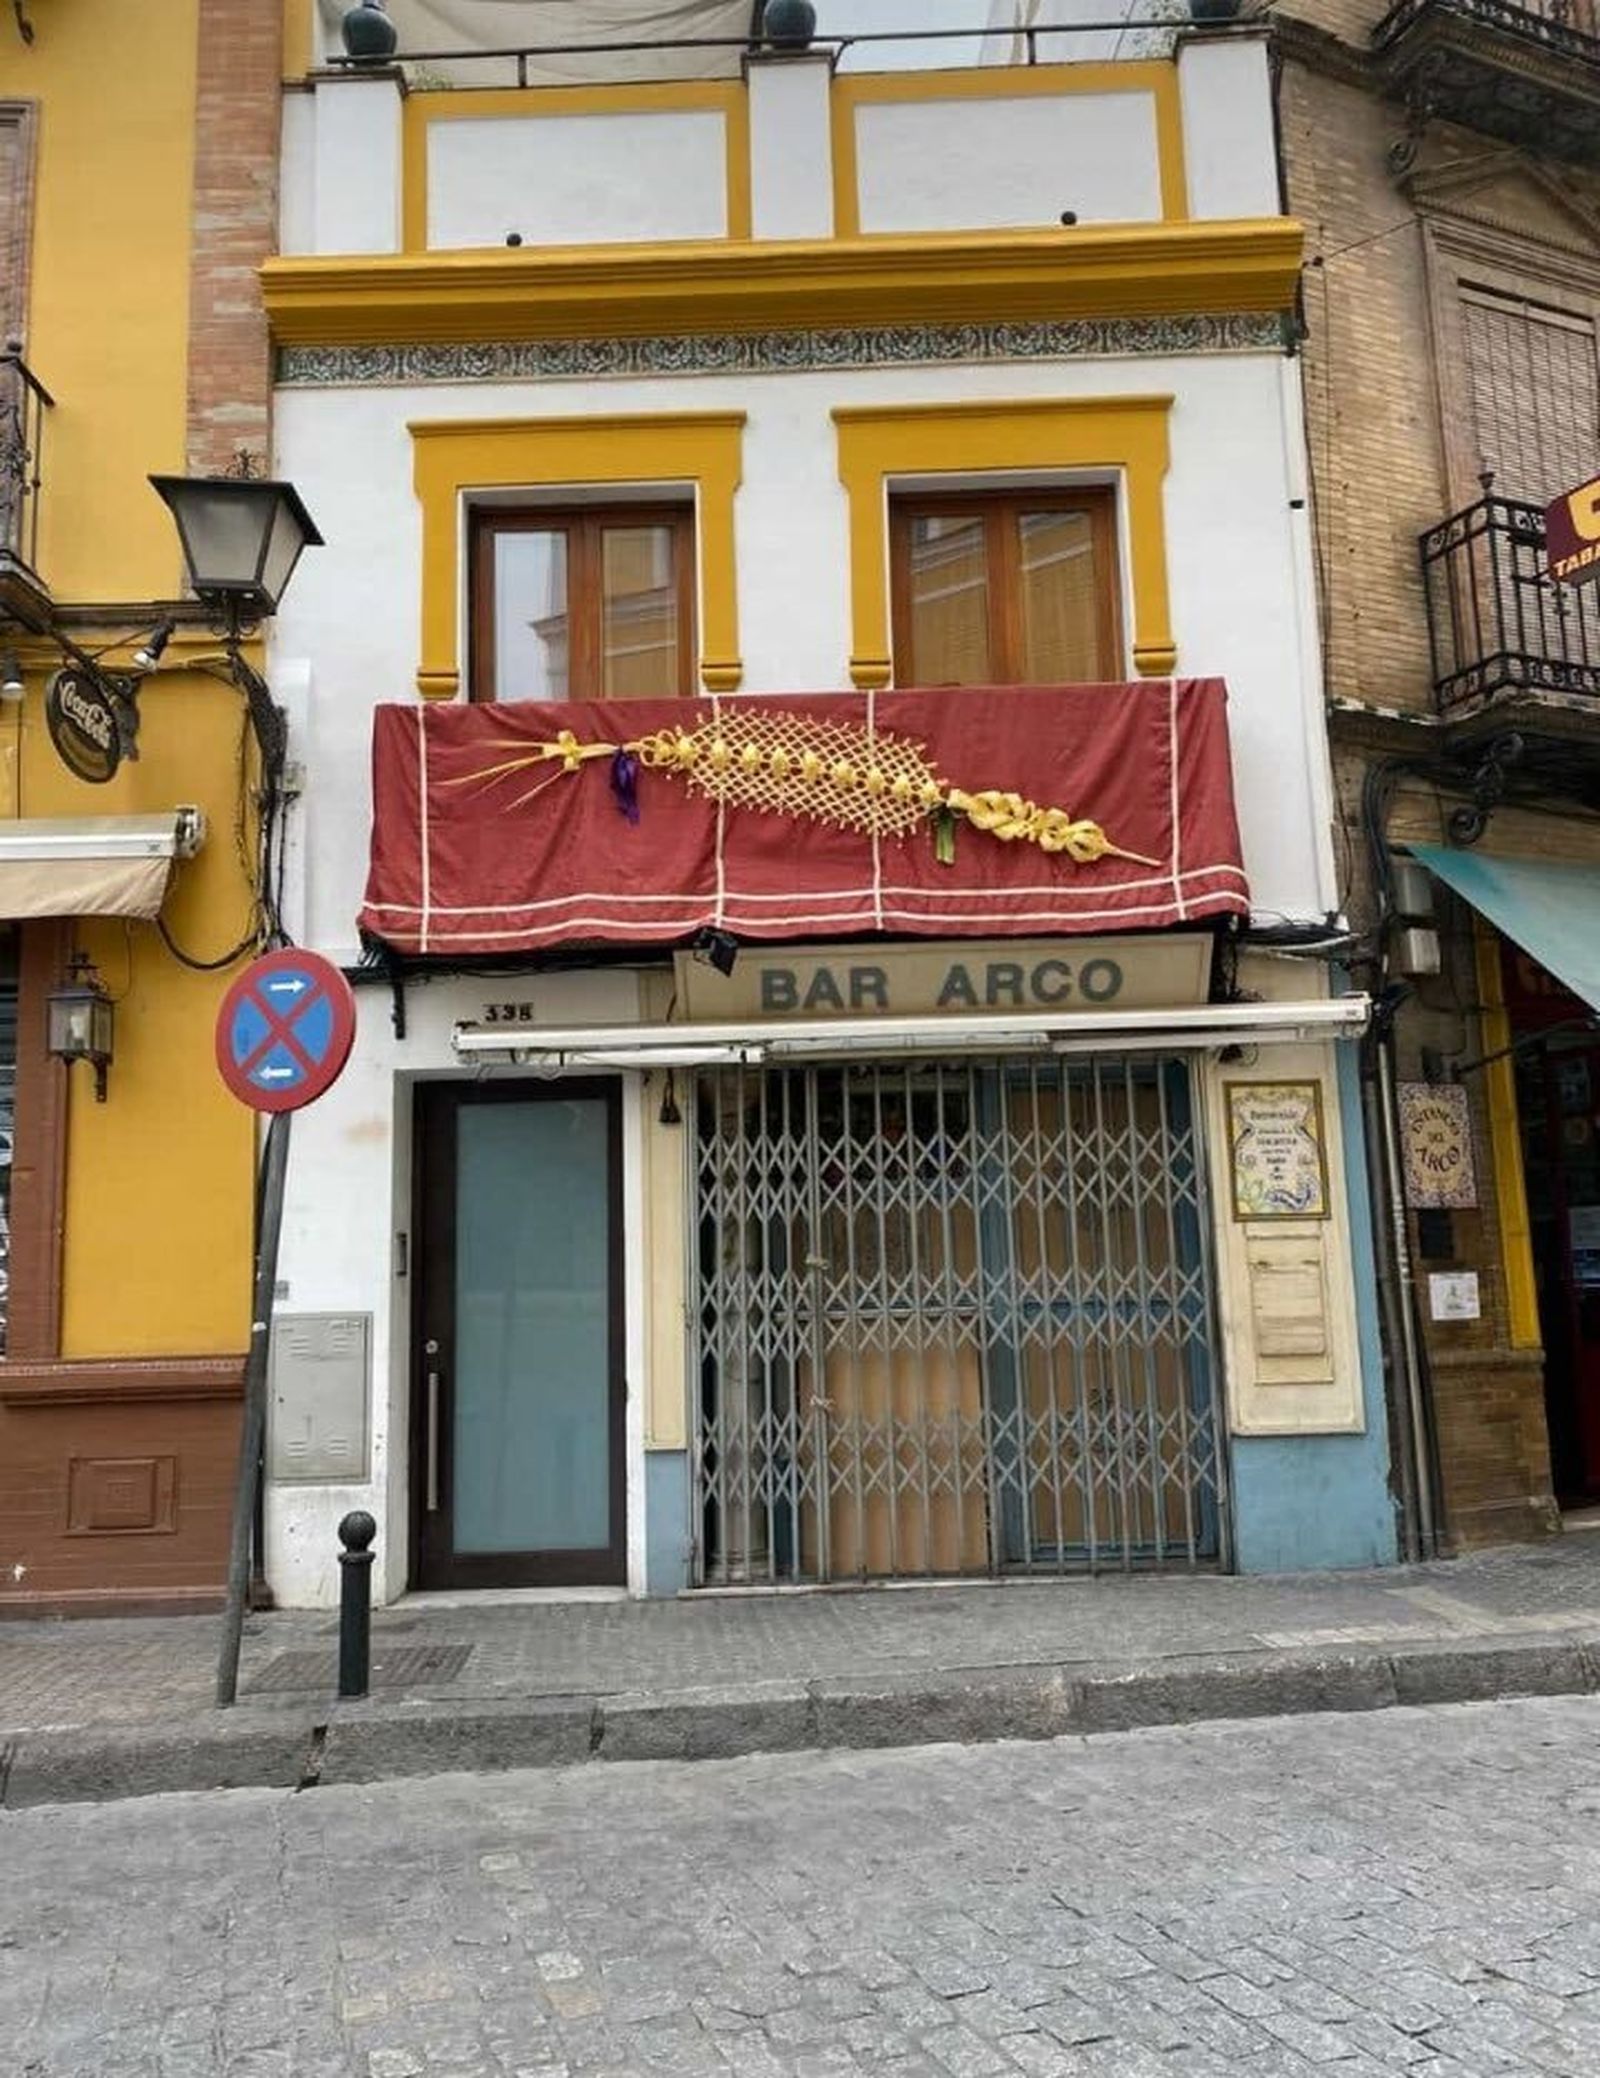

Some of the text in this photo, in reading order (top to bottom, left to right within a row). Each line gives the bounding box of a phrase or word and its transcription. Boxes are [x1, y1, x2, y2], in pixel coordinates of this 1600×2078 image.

[760, 958, 1124, 1012] BAR ARCO
[1415, 1146, 1460, 1173] ARCO
